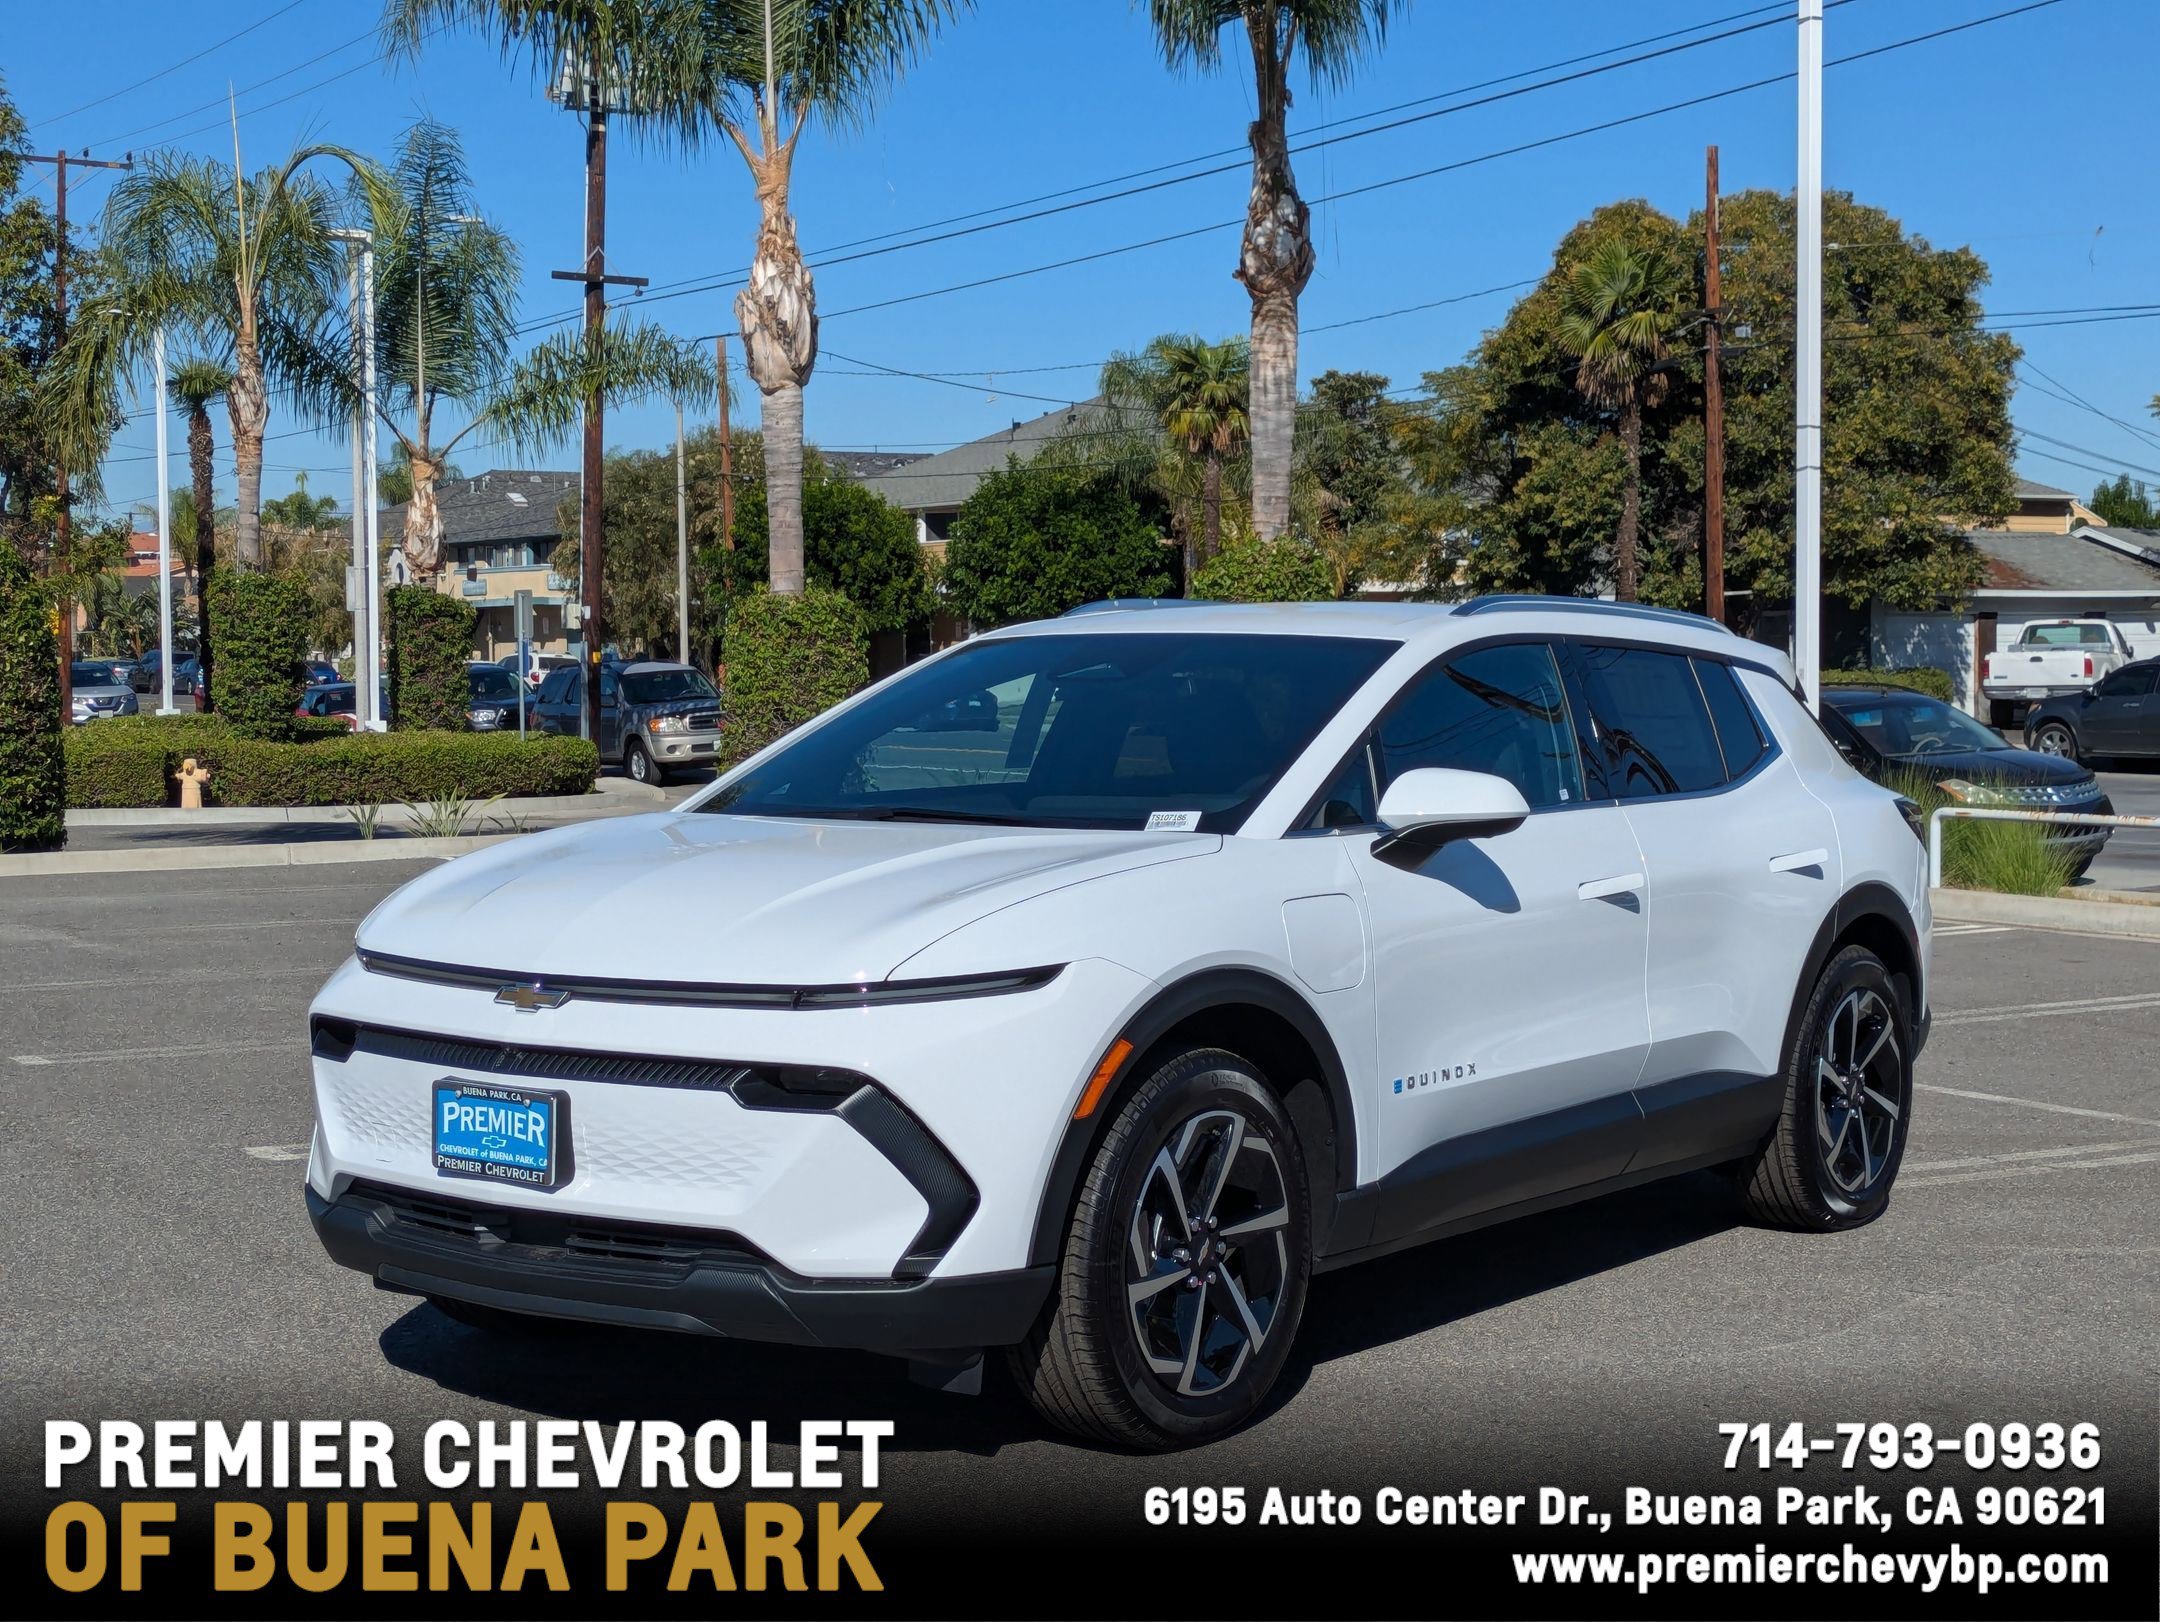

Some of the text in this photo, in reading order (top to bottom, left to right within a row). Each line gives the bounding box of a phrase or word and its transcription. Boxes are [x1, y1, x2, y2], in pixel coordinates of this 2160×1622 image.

[462, 1086, 488, 1098] BUENA
[1393, 1062, 1476, 1094] EQUINOX
[442, 1101, 546, 1148] PREMIER
[439, 1143, 479, 1157] CHEVROLET
[480, 1149, 489, 1157] of
[489, 1150, 514, 1162] BUENA
[515, 1154, 537, 1166] PARK,
[437, 1155, 545, 1183] PREMIER CHEVROLET
